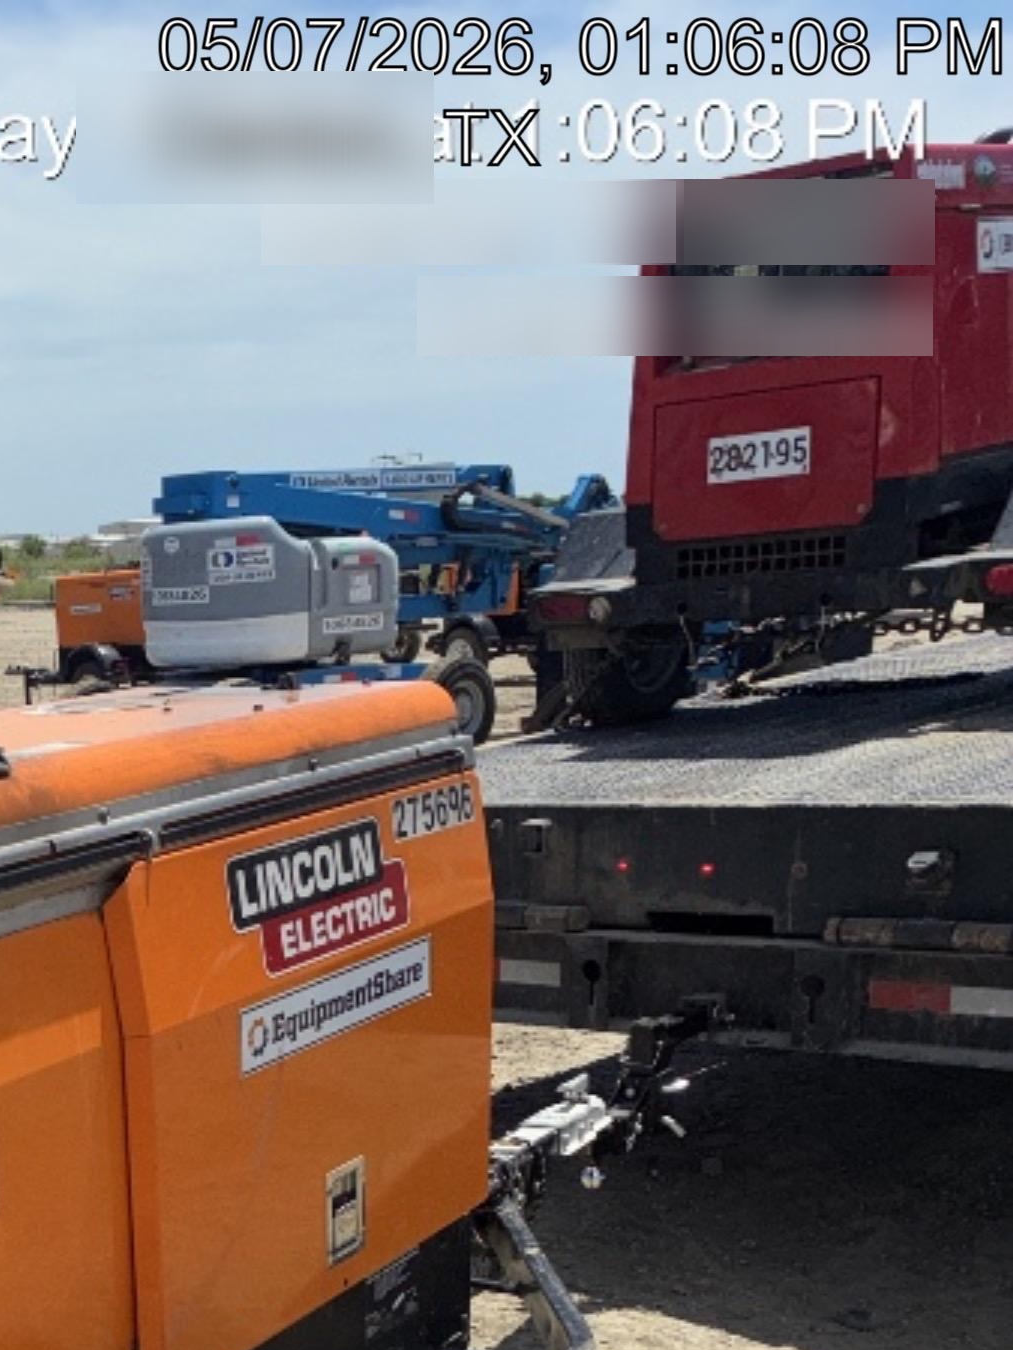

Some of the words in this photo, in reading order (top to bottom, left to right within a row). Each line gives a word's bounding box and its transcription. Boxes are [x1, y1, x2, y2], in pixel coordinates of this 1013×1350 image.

[393, 783, 473, 838] 275696
[235, 831, 377, 919] LINCOLN
[279, 887, 397, 960] ELECTRIC
[271, 959, 424, 1045] EquipmentShare
